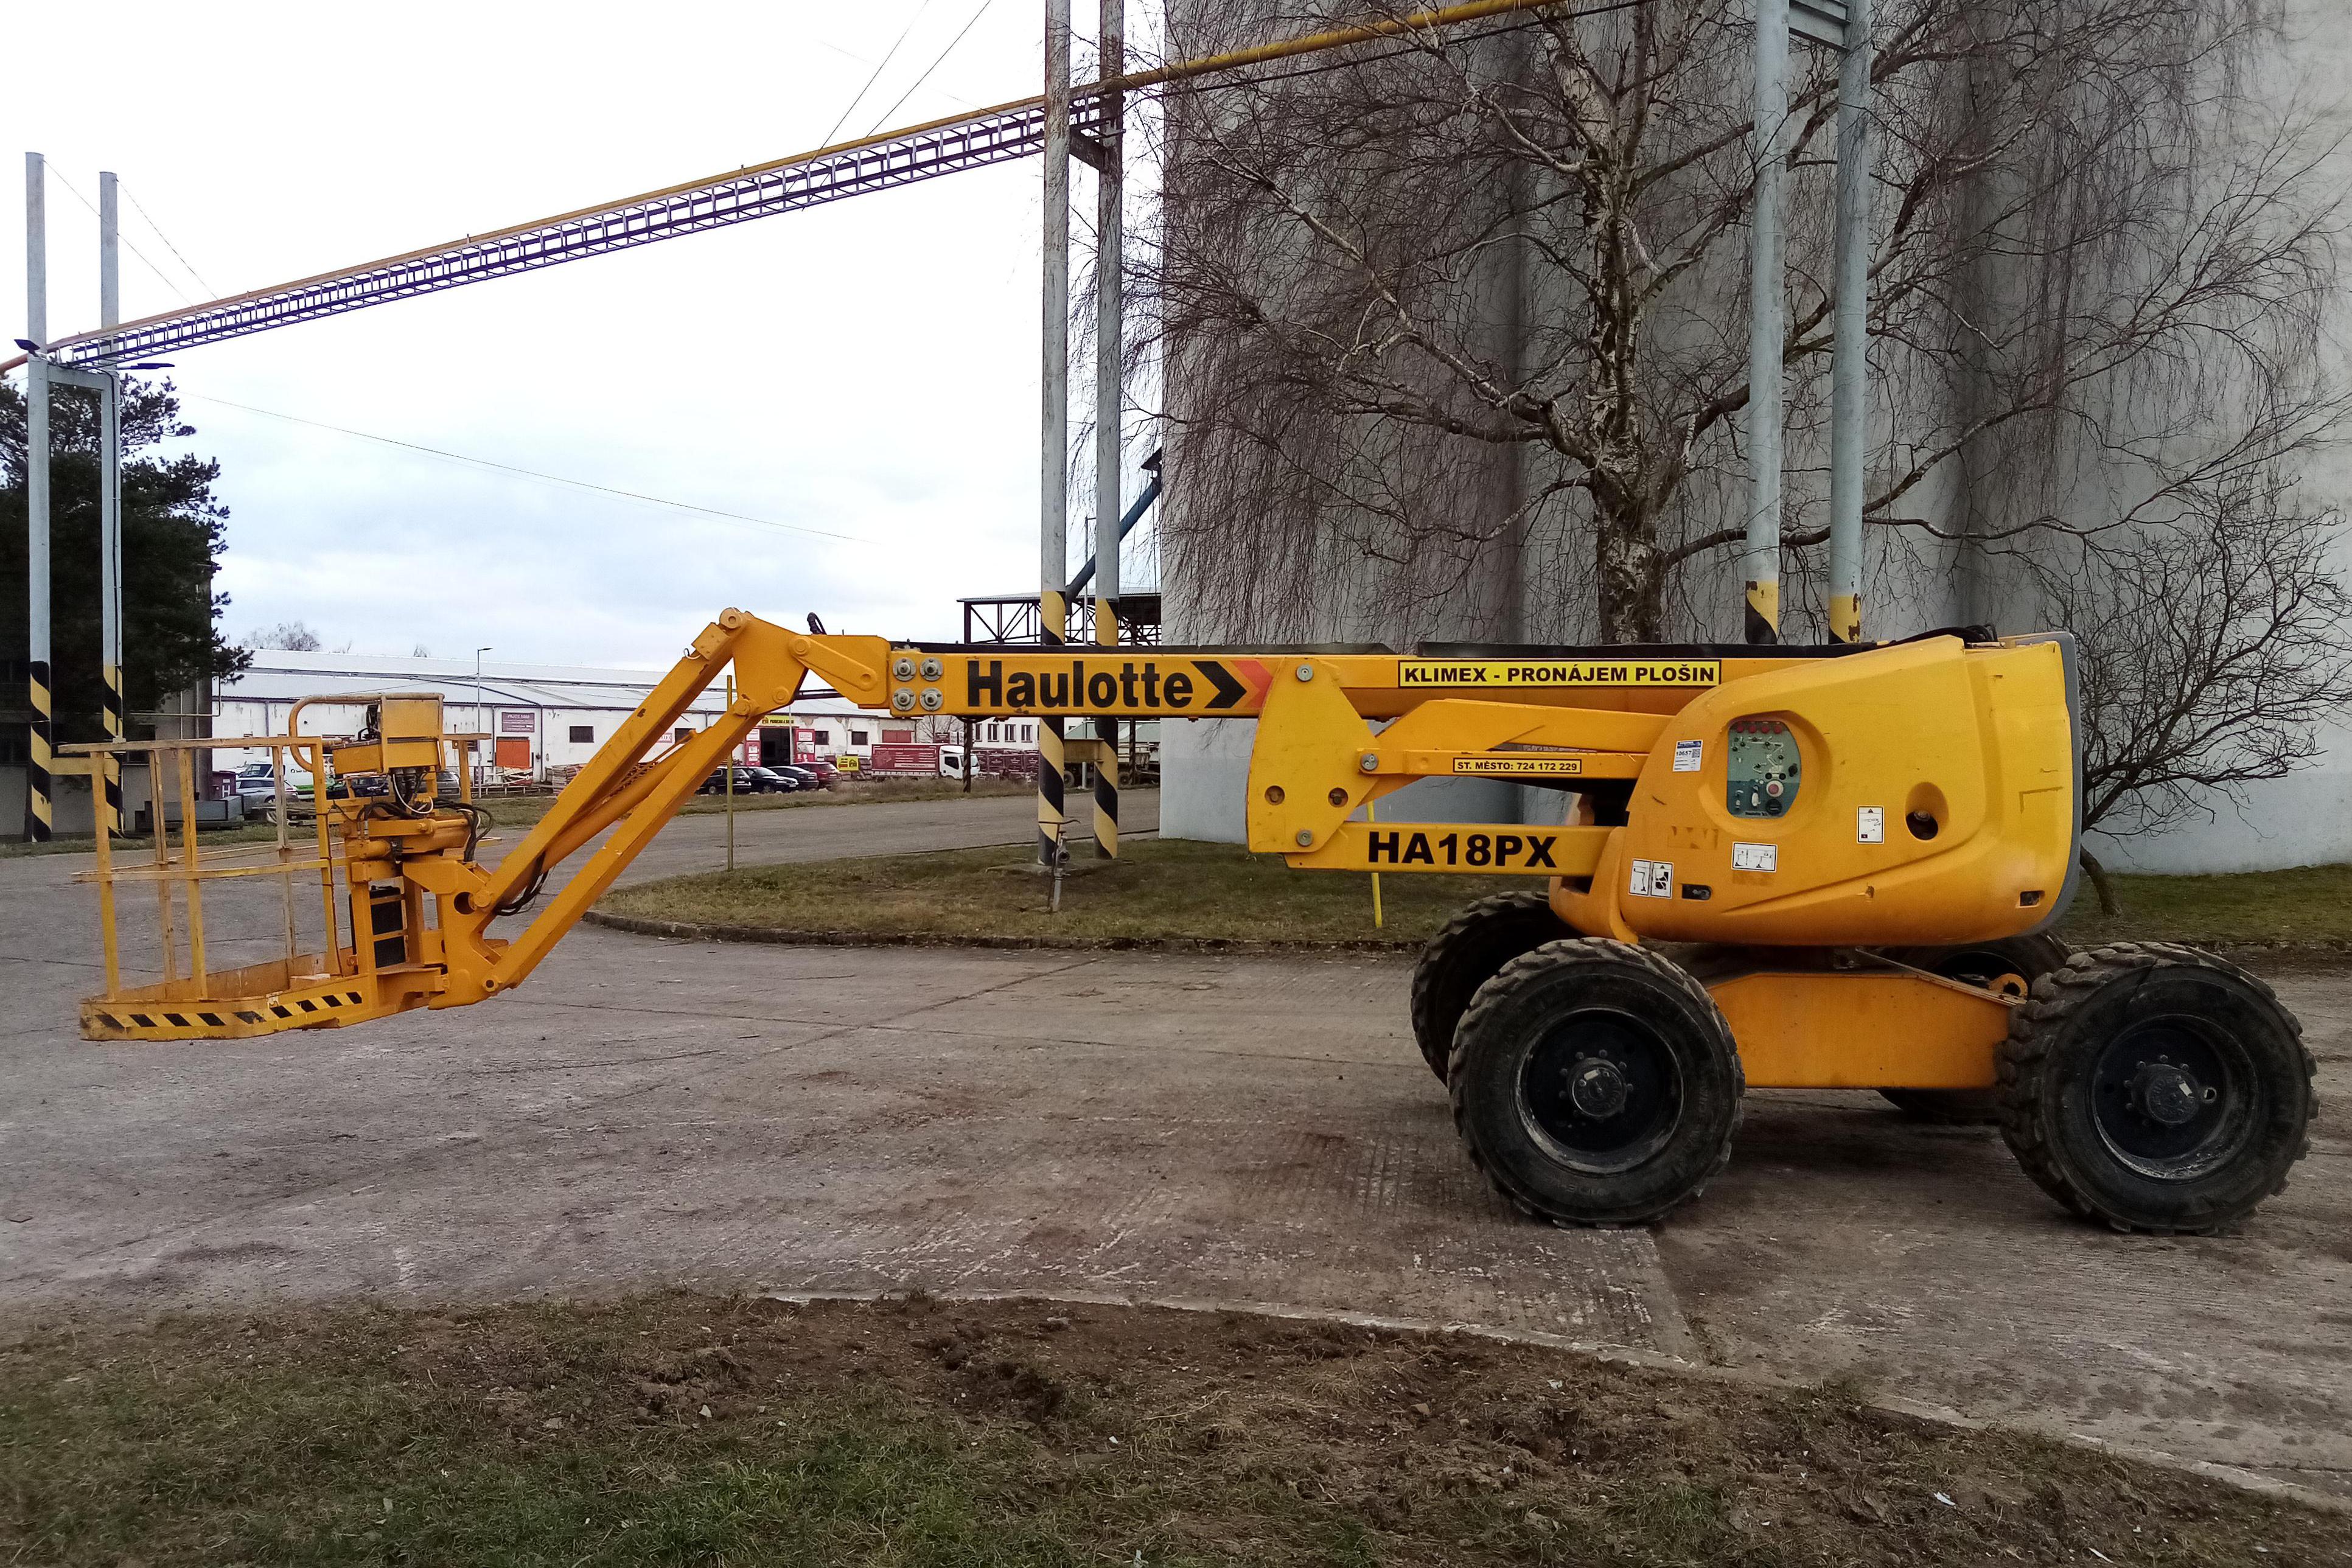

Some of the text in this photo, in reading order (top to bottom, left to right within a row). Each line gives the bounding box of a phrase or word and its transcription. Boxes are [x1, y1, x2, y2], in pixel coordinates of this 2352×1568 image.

[968, 660, 1193, 708] Haulotte
[1405, 667, 1487, 682] KLIMEX
[1507, 664, 1627, 681] PRONÁJEM
[1635, 664, 1714, 681] PLOŠIN
[1475, 761, 1513, 770] MĚSTO:
[1368, 831, 1557, 868] HA18PX
